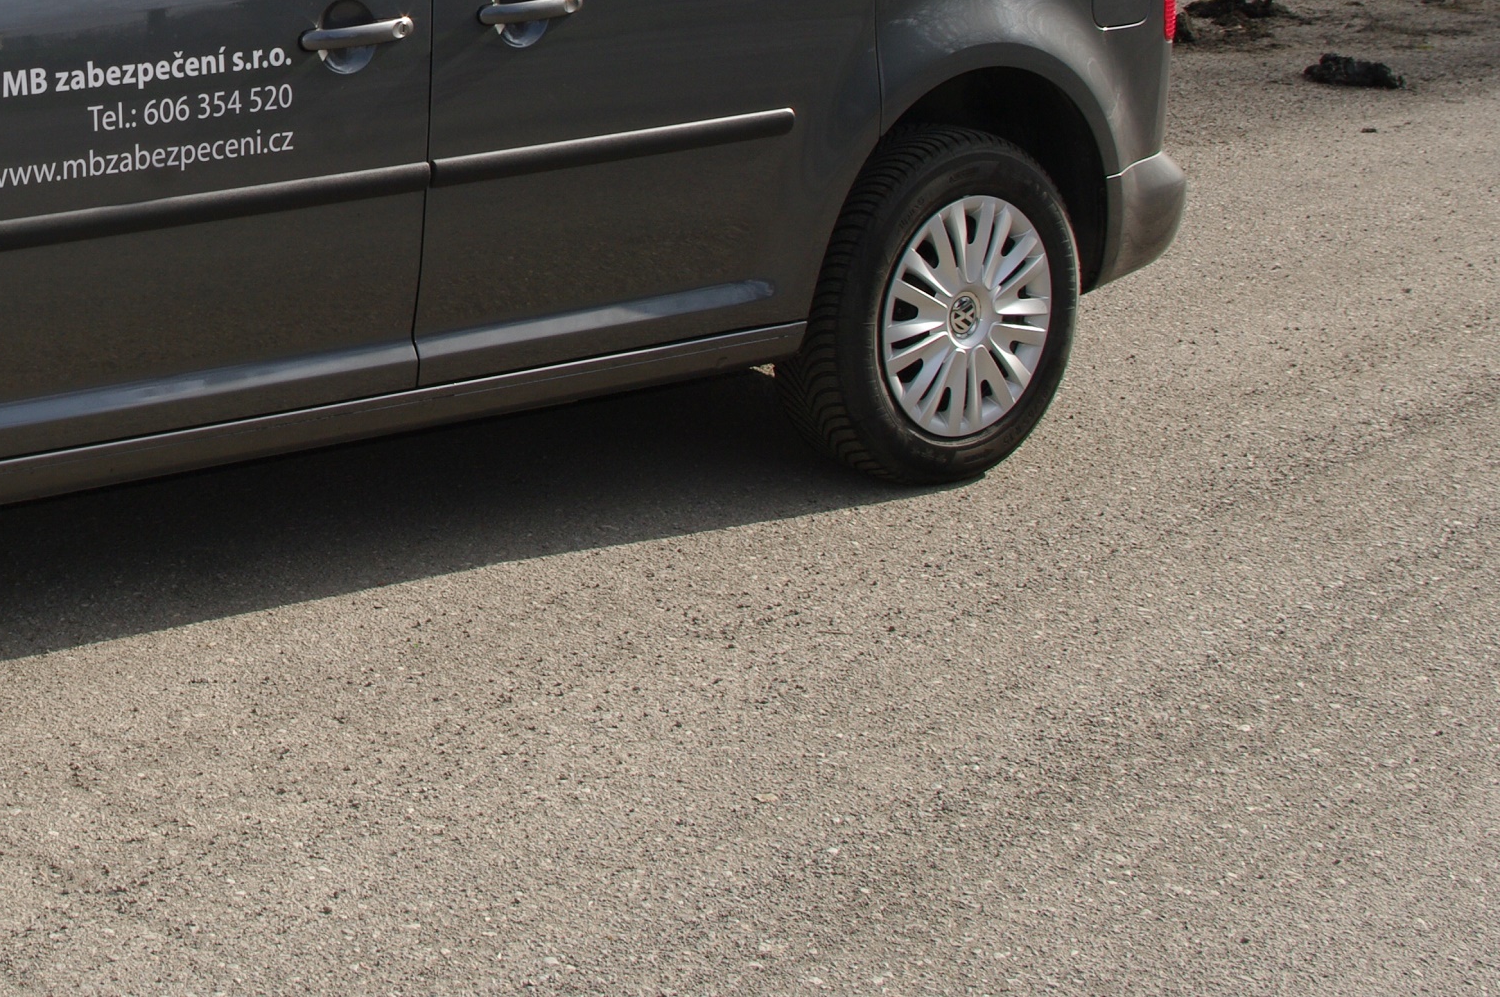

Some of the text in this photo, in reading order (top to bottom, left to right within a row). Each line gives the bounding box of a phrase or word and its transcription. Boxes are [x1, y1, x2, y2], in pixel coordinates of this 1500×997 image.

[2, 46, 292, 98] MB zabezpečení s.r.o.
[87, 84, 293, 132] Tel.: 606 354 520
